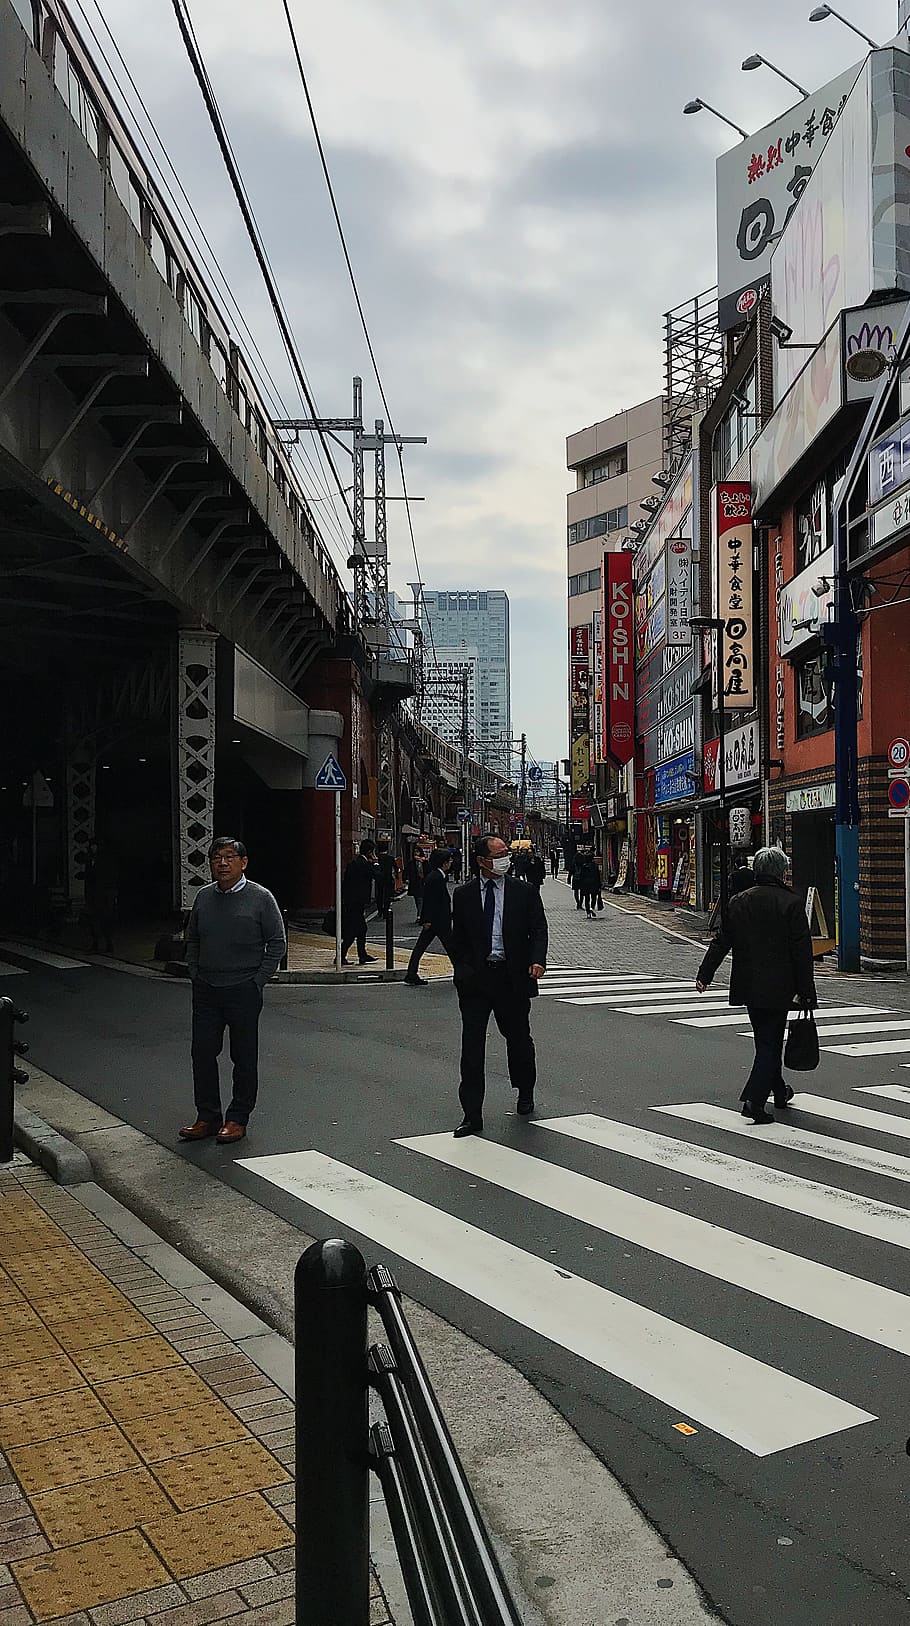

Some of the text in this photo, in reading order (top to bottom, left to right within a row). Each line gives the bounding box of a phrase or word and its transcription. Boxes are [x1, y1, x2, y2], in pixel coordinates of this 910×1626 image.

[720, 491, 750, 503] ちょい
[724, 505, 748, 517] 飲み
[727, 537, 744, 610] 中華食堂
[672, 630, 687, 640] 3F
[724, 617, 749, 697] 日高屋
[776, 662, 784, 750] HOUSE
[892, 746, 906, 760] 20
